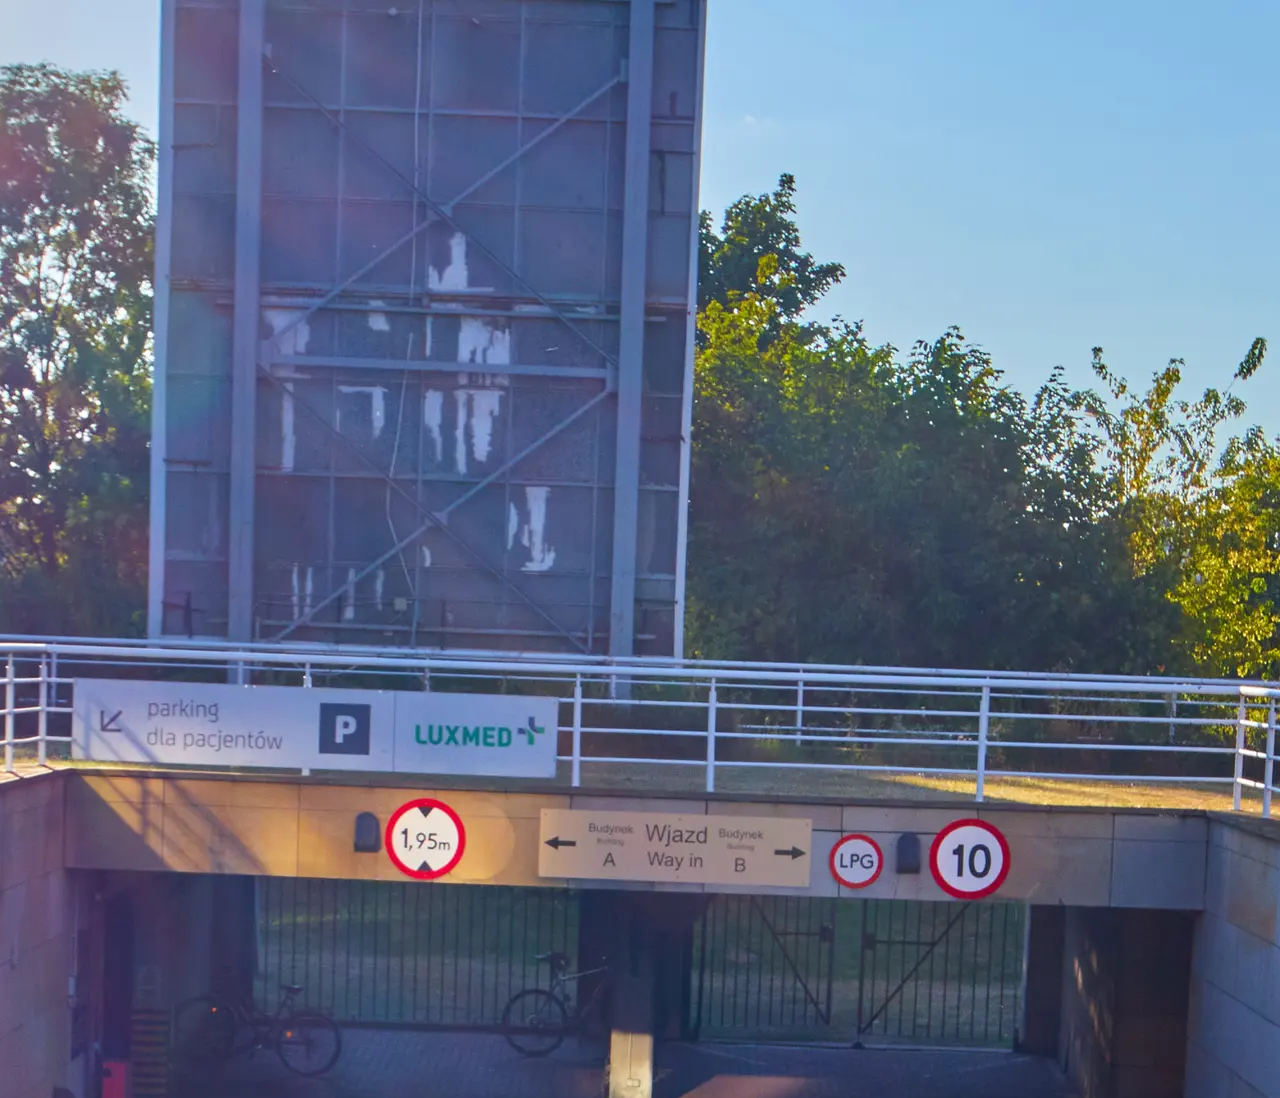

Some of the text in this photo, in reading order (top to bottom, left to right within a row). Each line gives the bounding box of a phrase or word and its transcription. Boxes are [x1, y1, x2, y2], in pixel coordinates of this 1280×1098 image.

[147, 699, 219, 723] parking
[146, 729, 283, 752] dla pacjentów
[335, 716, 357, 744] P
[415, 724, 512, 748] LUXMED
[588, 822, 634, 835] Budynek
[645, 824, 708, 847] Wjazd
[718, 828, 764, 841] Budynek
[603, 851, 616, 867] A
[647, 851, 703, 870] Way in
[734, 857, 746, 873] B
[839, 853, 874, 870] LPG
[951, 843, 992, 879] 10
